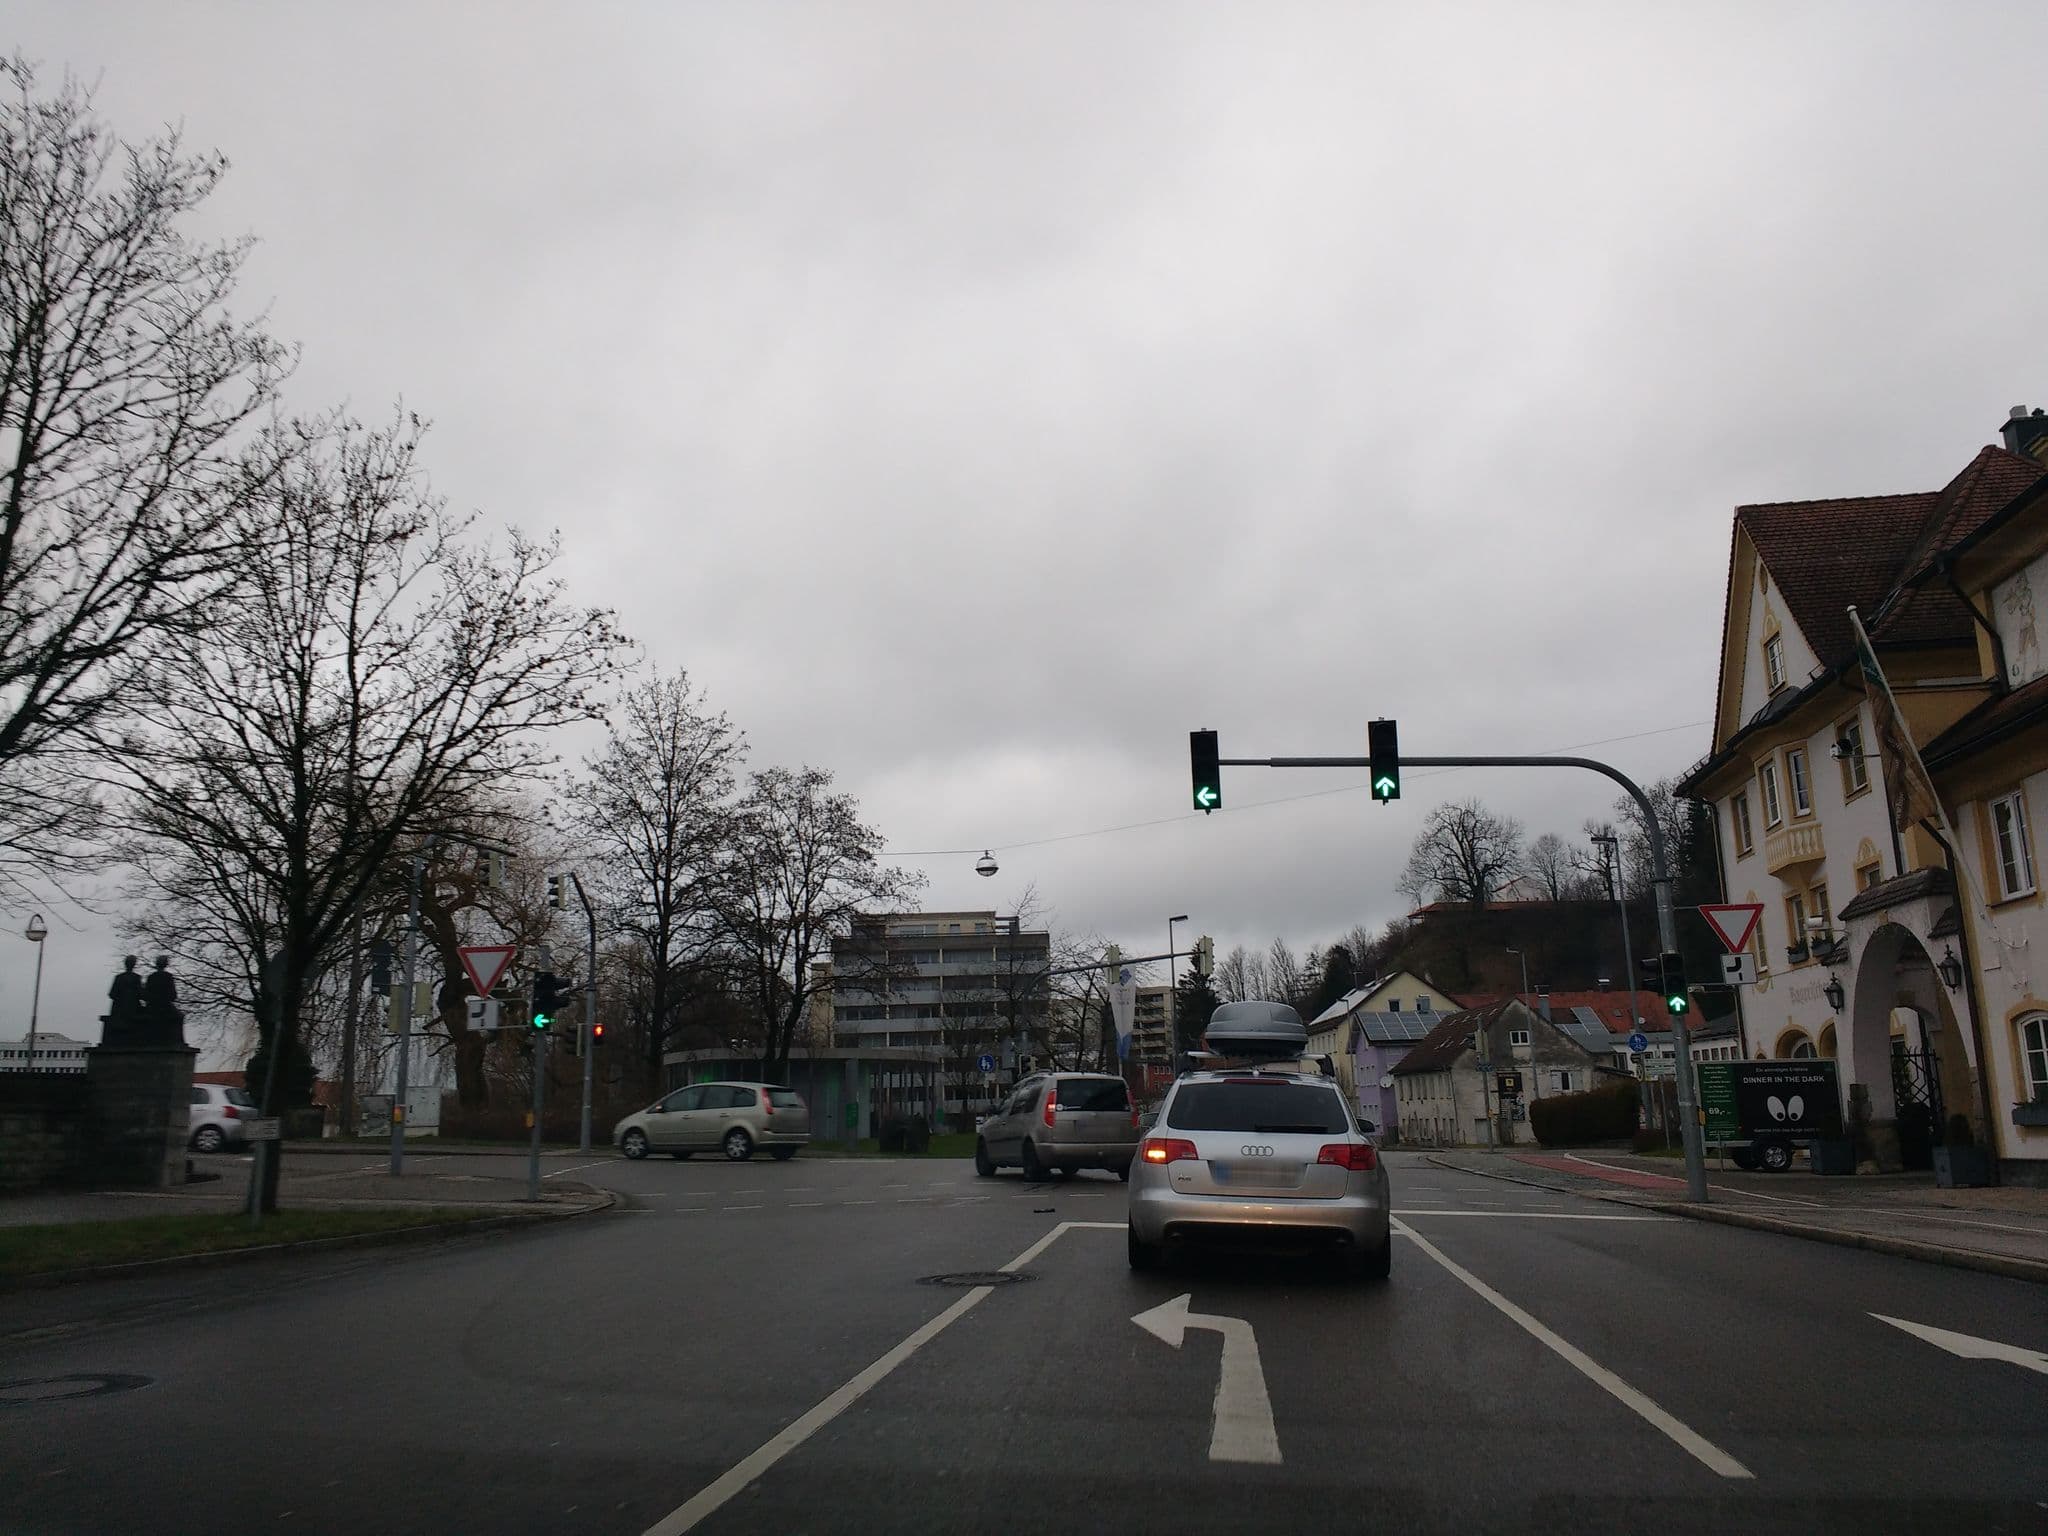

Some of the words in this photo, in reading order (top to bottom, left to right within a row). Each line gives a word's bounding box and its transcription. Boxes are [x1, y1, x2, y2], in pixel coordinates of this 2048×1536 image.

[1743, 1076, 1773, 1084] DINNER
[1785, 1075, 1801, 1083] THE
[1802, 1075, 1825, 1083] DARK
